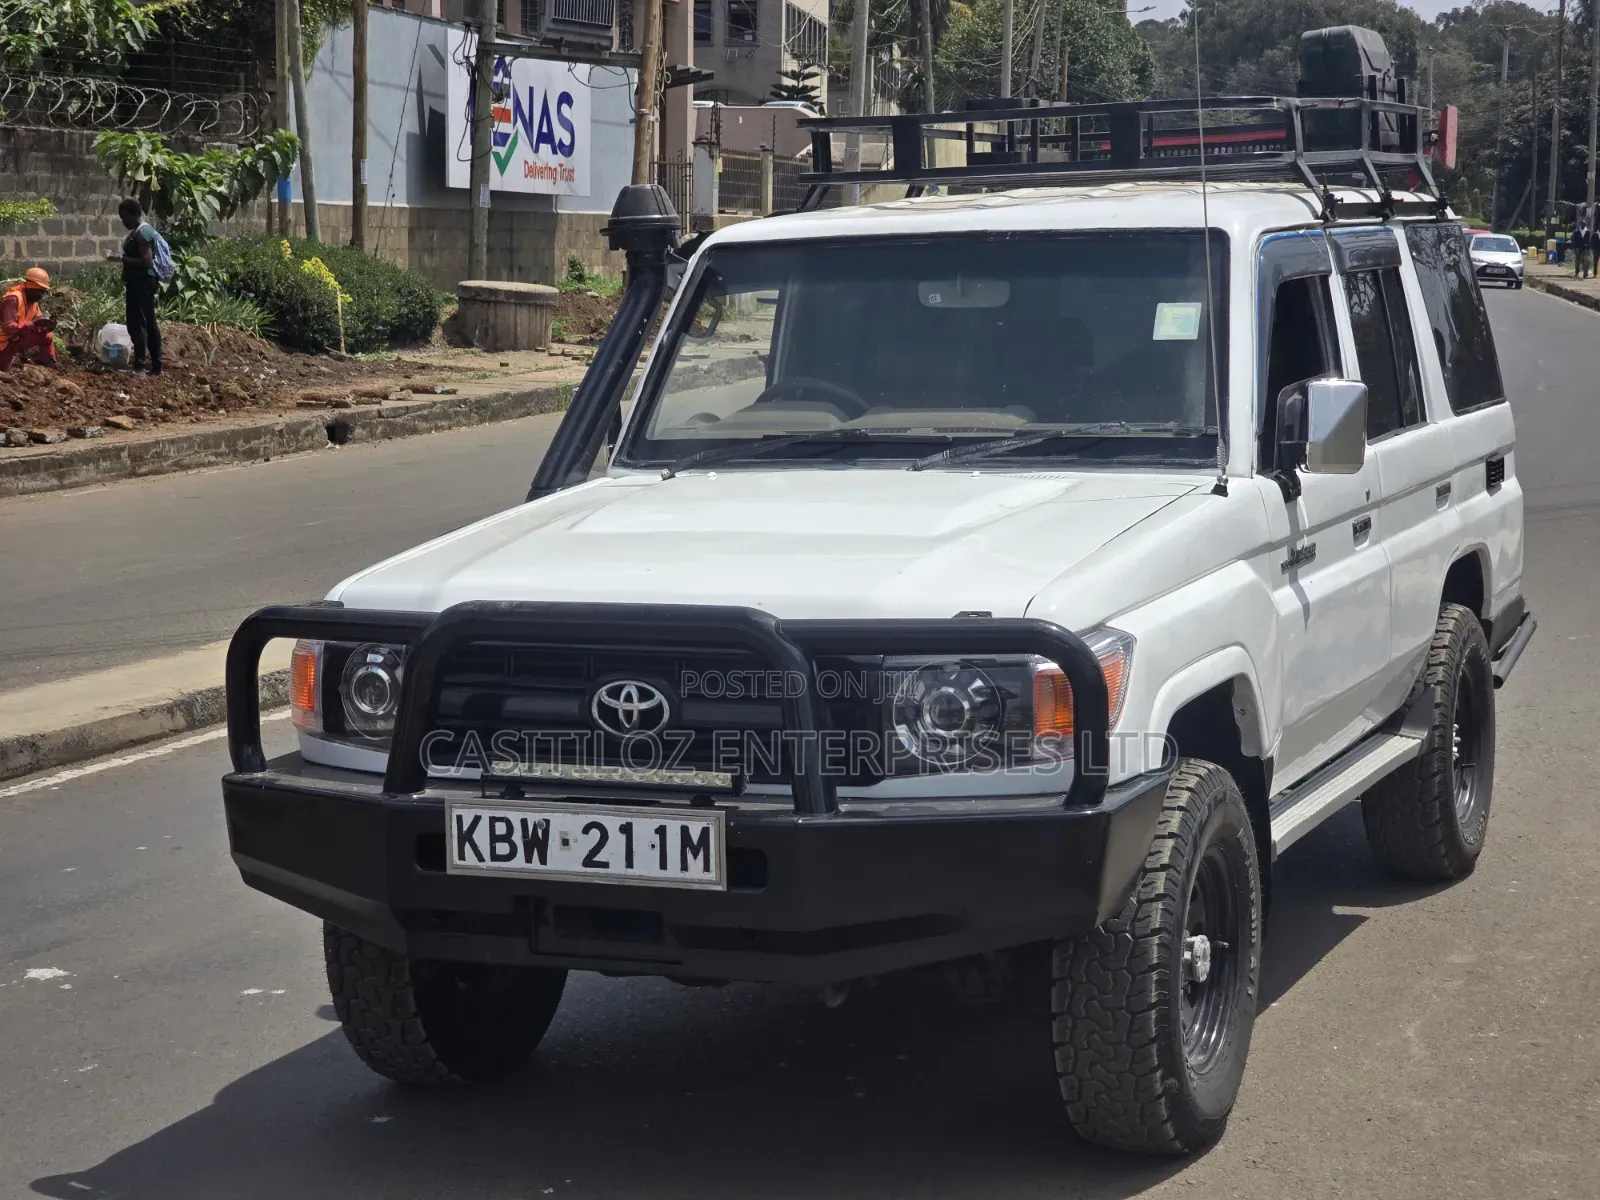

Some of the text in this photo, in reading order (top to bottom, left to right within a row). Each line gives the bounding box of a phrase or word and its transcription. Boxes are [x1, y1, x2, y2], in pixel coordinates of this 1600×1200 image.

[523, 160, 575, 184] Delivering Trust
[455, 814, 711, 874] KBW 211M
